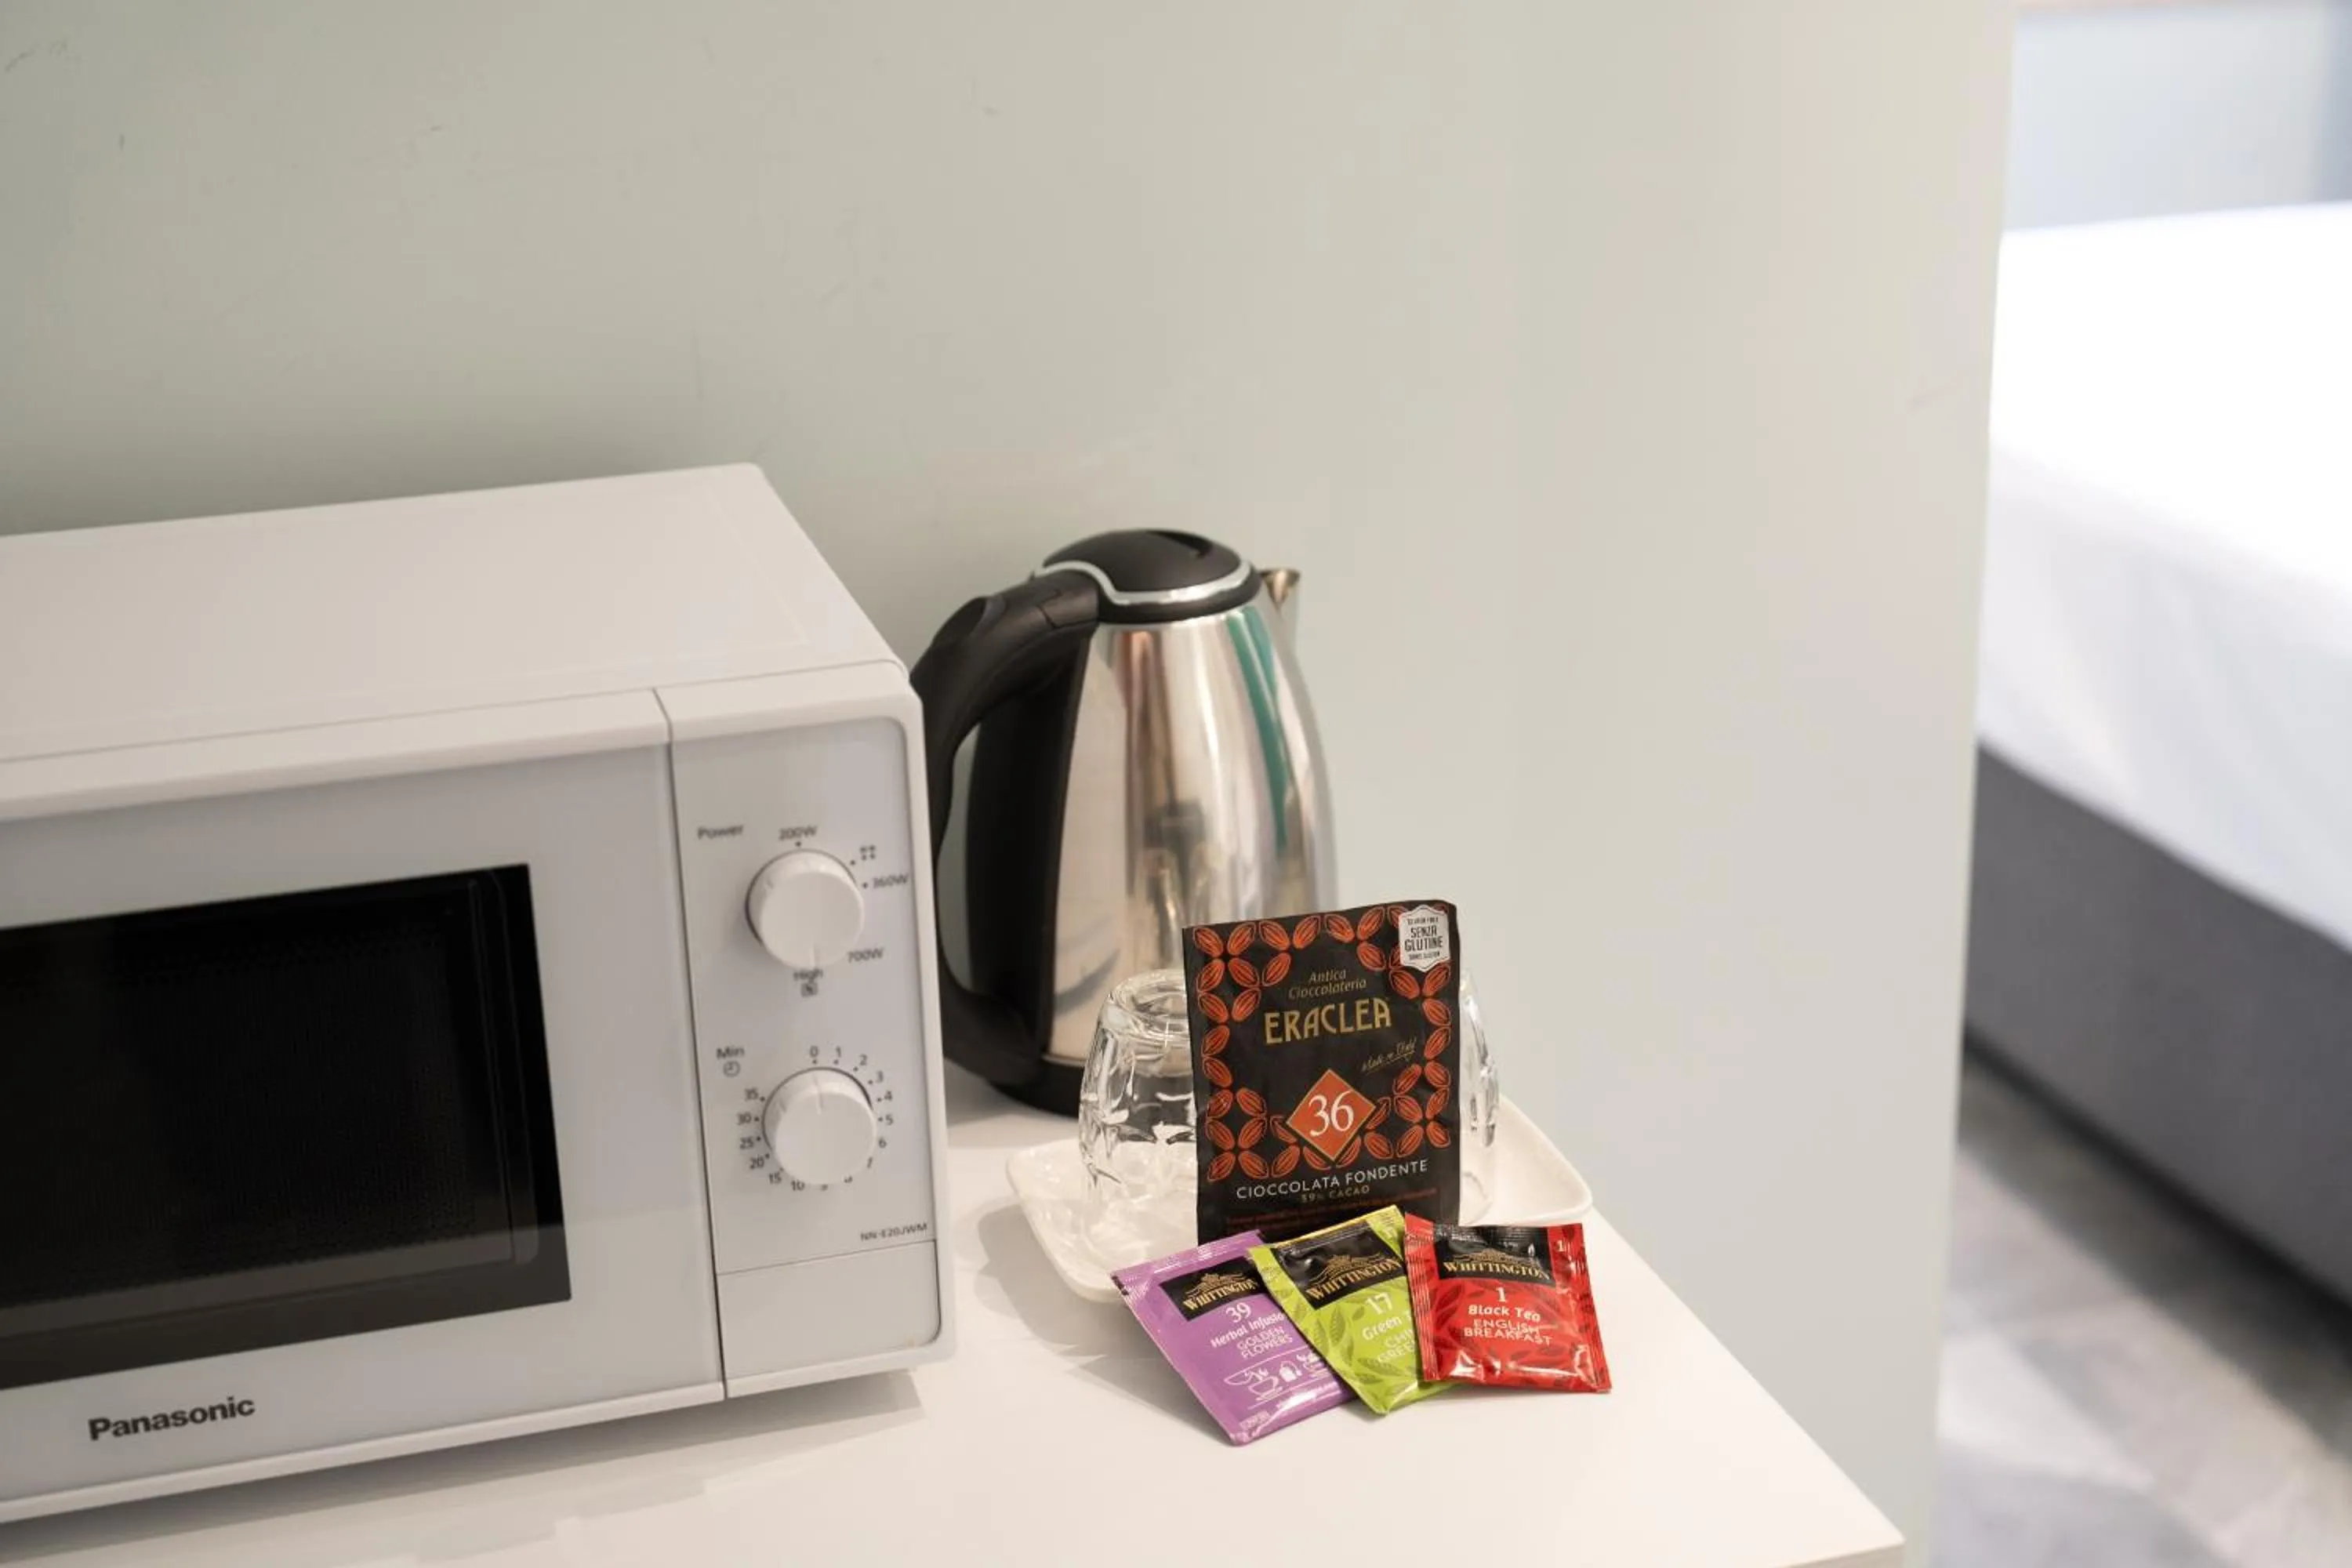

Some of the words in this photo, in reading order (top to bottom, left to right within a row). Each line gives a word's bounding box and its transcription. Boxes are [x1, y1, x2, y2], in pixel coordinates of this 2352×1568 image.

[697, 825, 743, 840] Power
[779, 825, 818, 841] 200W
[1410, 925, 1437, 938] SENZA
[848, 947, 884, 963] 700W
[1308, 968, 1347, 983] Antica
[1287, 978, 1367, 1000] Cioccolateria
[1264, 997, 1392, 1045] ERACLEA
[717, 1047, 745, 1059] Min
[809, 1046, 818, 1058] 0
[835, 1047, 842, 1057] 1
[859, 1054, 868, 1066] 2
[876, 1072, 884, 1083] 3
[745, 1087, 759, 1101] 35
[884, 1091, 892, 1102] 4
[737, 1113, 752, 1125] 30
[886, 1115, 894, 1125] 5
[1307, 1091, 1354, 1137] 36
[740, 1138, 754, 1149] 25
[879, 1138, 887, 1149] 6
[750, 1157, 764, 1169] 20
[768, 1174, 782, 1185] 15
[790, 1180, 805, 1192] 10
[1236, 1174, 1340, 1200] CIOCCOLATA
[1345, 1160, 1429, 1185] FONDENTE
[1329, 1185, 1370, 1200] CACAO
[1443, 1261, 1550, 1280] WHITTINGTON
[1305, 1258, 1402, 1301] WHITTINGTON
[1497, 1287, 1506, 1302] 1
[1366, 1292, 1392, 1315] 17
[1225, 1302, 1251, 1323] 39
[1468, 1305, 1509, 1317] Black
[1515, 1307, 1541, 1323] Tea
[1363, 1316, 1403, 1341] Green
[1473, 1318, 1541, 1335] ENGLISH
[1210, 1325, 1249, 1348] Herbal
[1236, 1326, 1285, 1351] GOLDEN
[1463, 1327, 1553, 1346] BREAKFAST
[1241, 1334, 1293, 1359] FLOWERS
[89, 1396, 255, 1440] Panasonic
